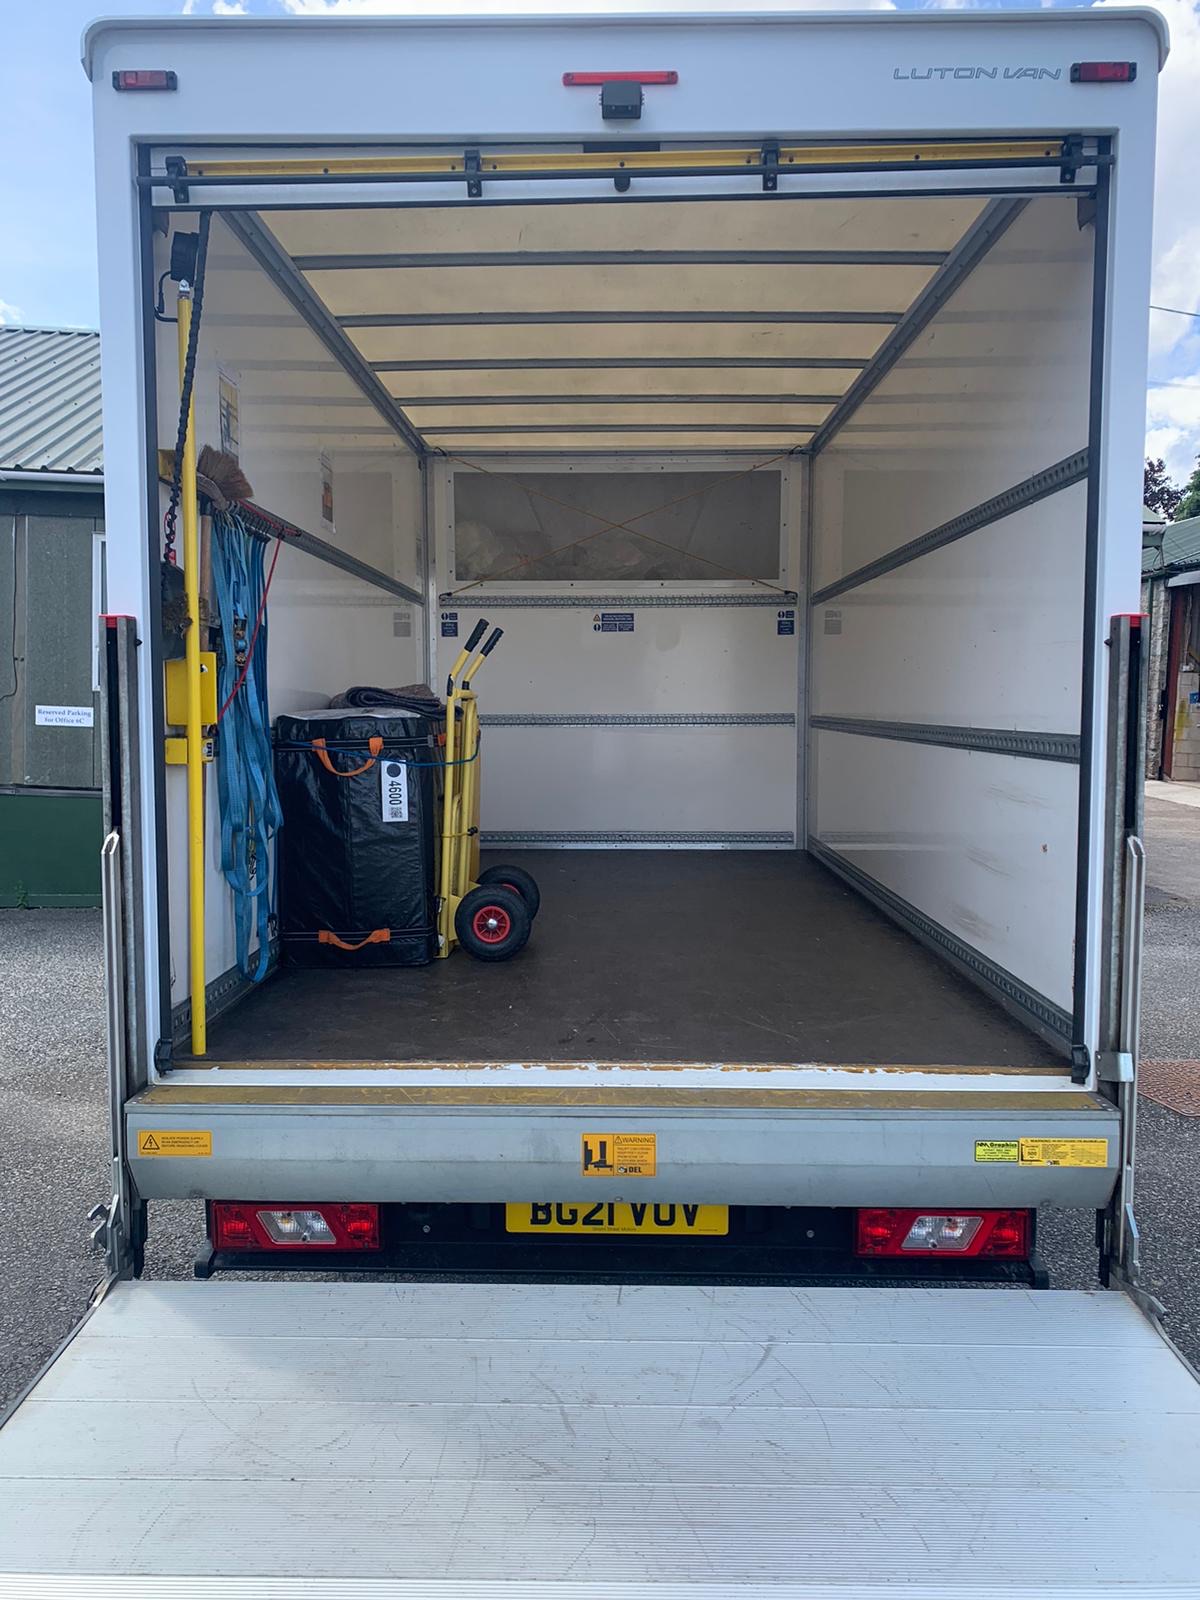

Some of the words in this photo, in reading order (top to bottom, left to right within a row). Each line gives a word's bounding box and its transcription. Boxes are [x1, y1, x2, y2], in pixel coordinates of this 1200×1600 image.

[893, 67, 999, 80] LUTON
[1002, 67, 1062, 80] VAN
[67, 710, 92, 718] Parking
[388, 780, 403, 806] 4600
